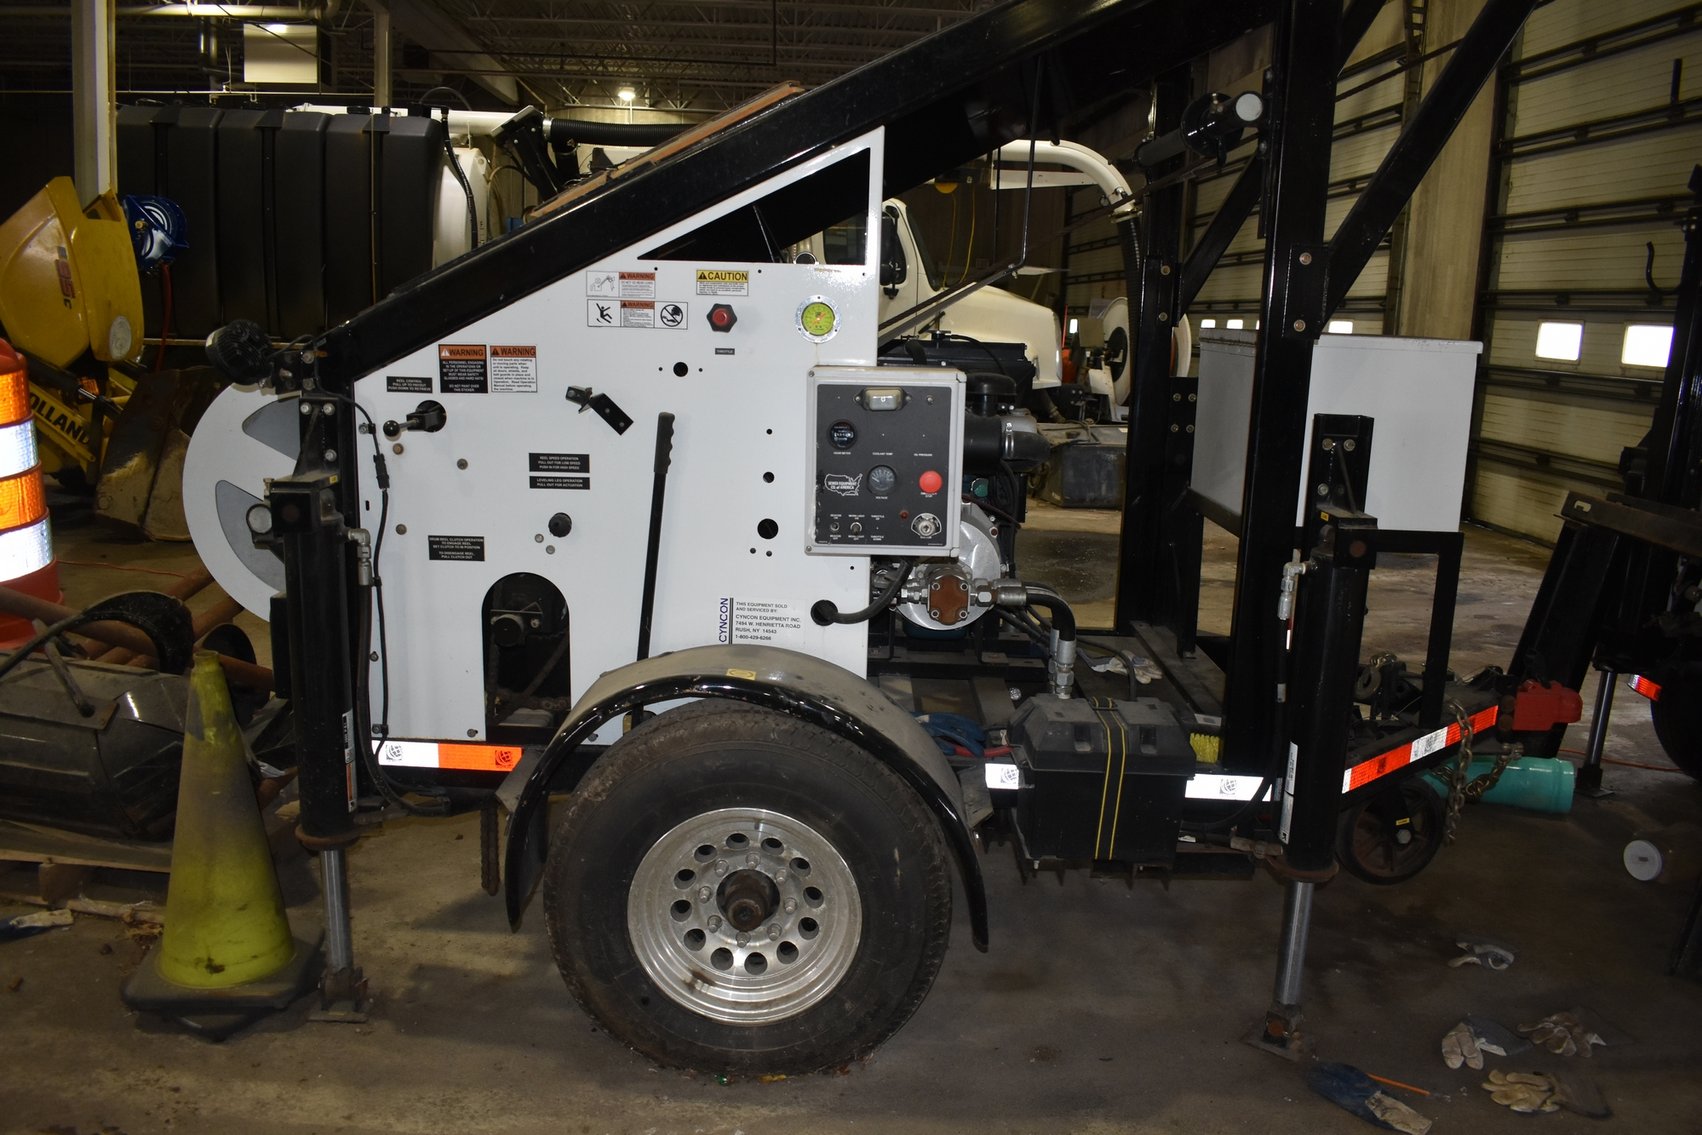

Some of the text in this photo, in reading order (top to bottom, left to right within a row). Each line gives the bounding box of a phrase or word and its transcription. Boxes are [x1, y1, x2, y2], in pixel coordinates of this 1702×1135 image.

[708, 272, 747, 280] CAUTION
[30, 392, 90, 444] OLLAND
[719, 598, 728, 642] CYNCON
